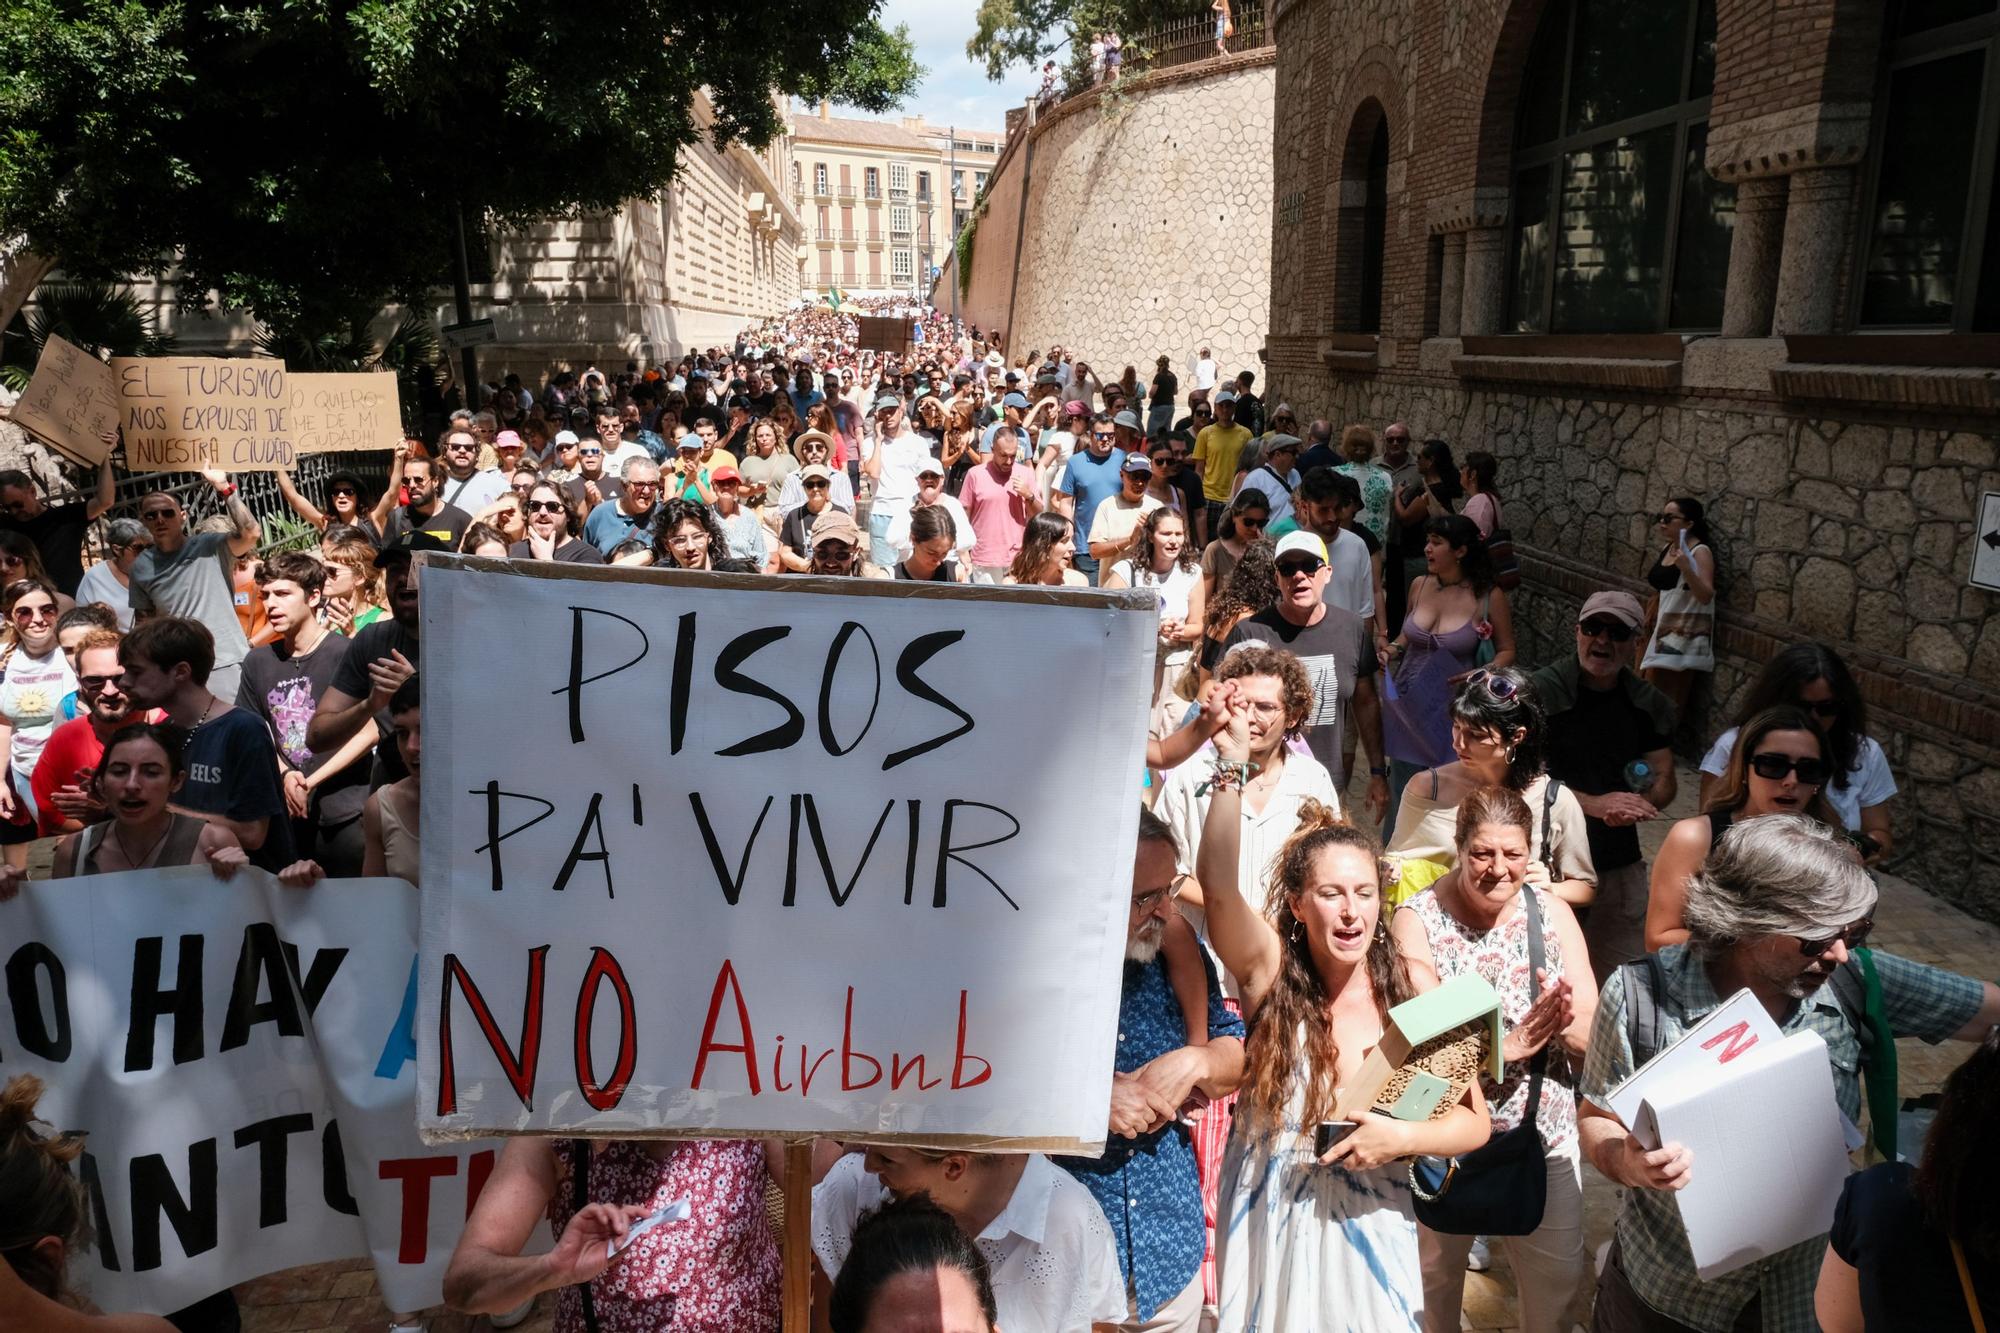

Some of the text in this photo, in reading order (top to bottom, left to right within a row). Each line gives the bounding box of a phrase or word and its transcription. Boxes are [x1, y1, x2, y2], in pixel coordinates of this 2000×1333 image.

[121, 364, 283, 399] EL TURISMO
[314, 388, 379, 411] QUIERO
[129, 405, 288, 432] NOS EXPULSA DE
[325, 412, 349, 429] DE
[358, 411, 379, 429] MI
[136, 437, 219, 465] NUESTRA
[551, 606, 975, 771] PISOS
[190, 762, 222, 784] EELS
[468, 780, 1021, 911] PA' VIVIR
[0, 942, 72, 1063] O
[124, 921, 350, 1073] HAY
[436, 943, 638, 1117] NO
[690, 959, 993, 1097] Airbnb
